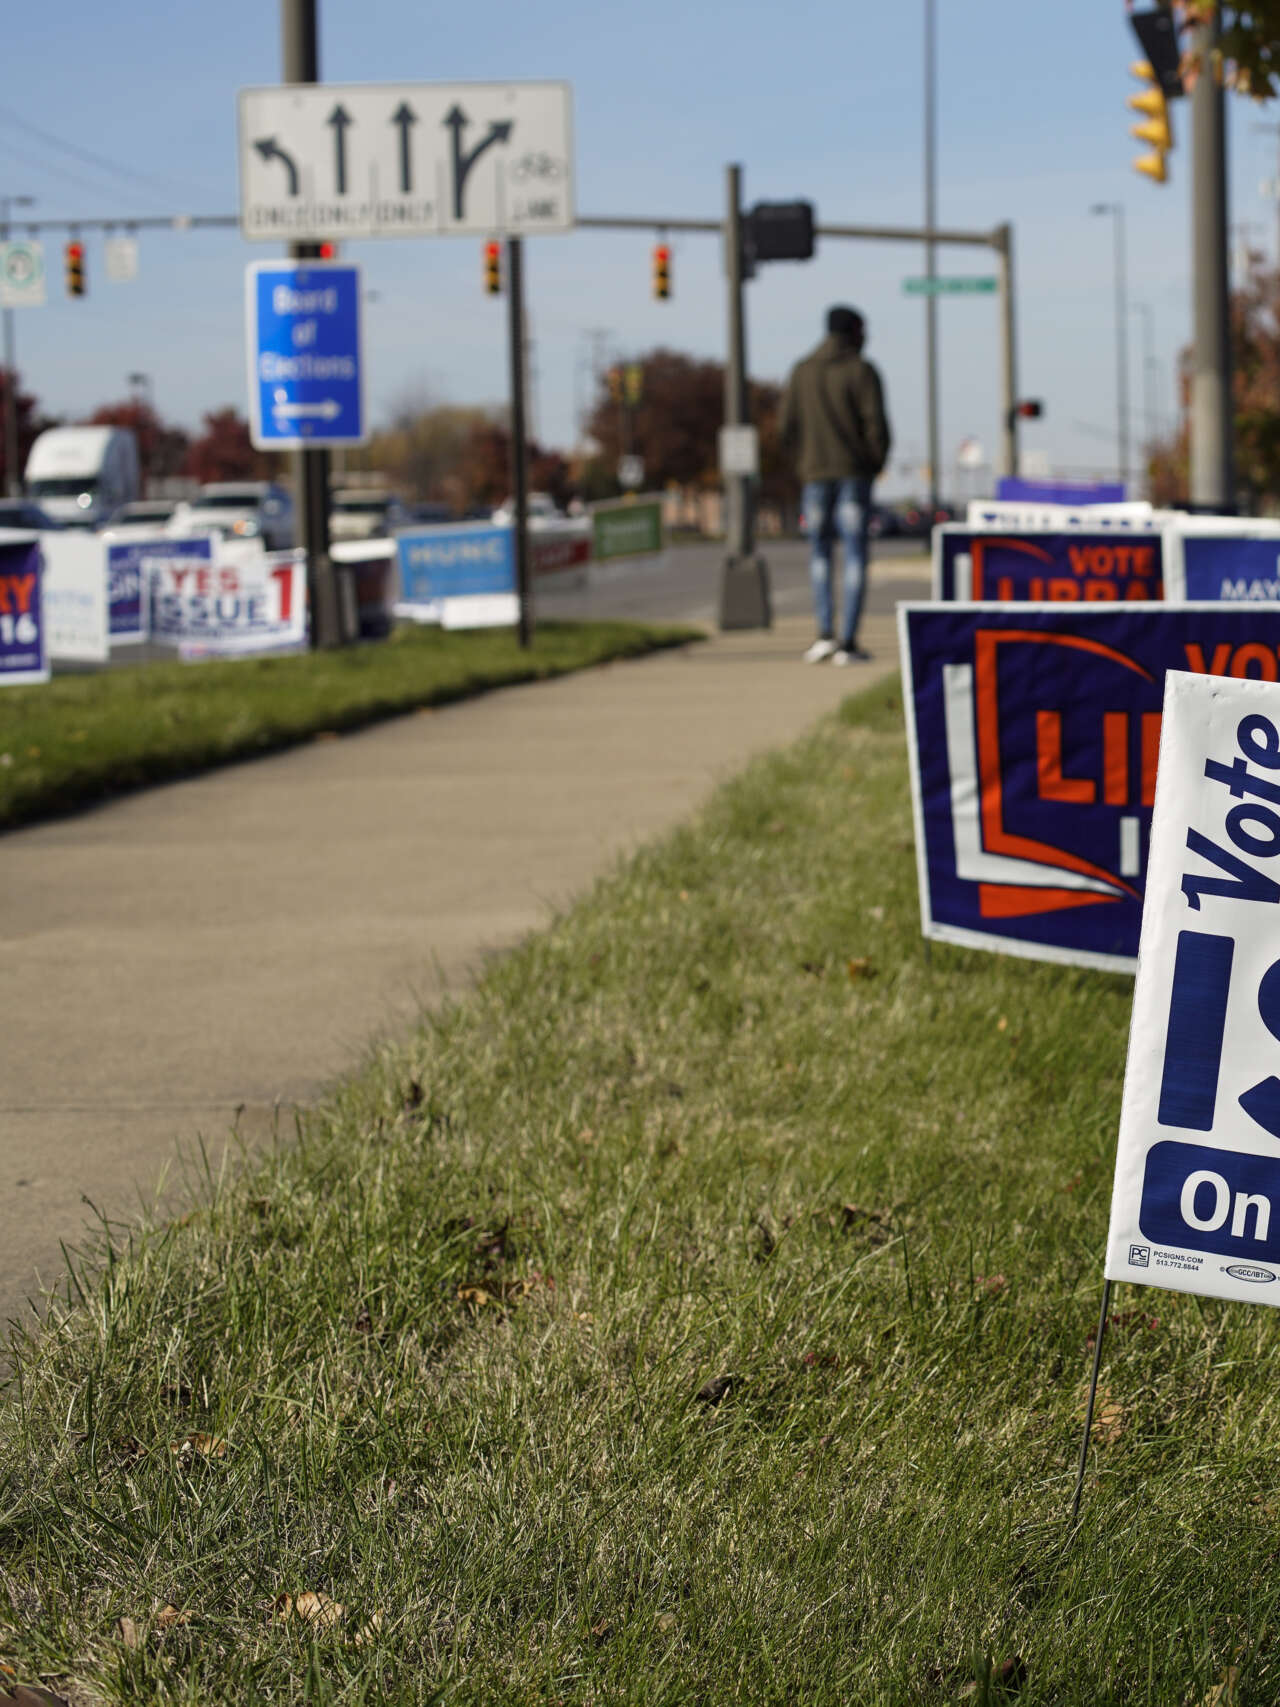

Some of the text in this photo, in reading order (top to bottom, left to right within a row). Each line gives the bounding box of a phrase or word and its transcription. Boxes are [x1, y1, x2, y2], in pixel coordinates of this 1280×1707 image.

[274, 287, 336, 313] Board
[293, 320, 316, 345] of
[261, 353, 353, 380] Elections
[1068, 545, 1154, 577] VOTE
[170, 565, 240, 593] YES
[271, 564, 293, 622] 1
[1179, 1169, 1271, 1242] On
[1153, 1250, 1204, 1264] PCSIGNS.COM
